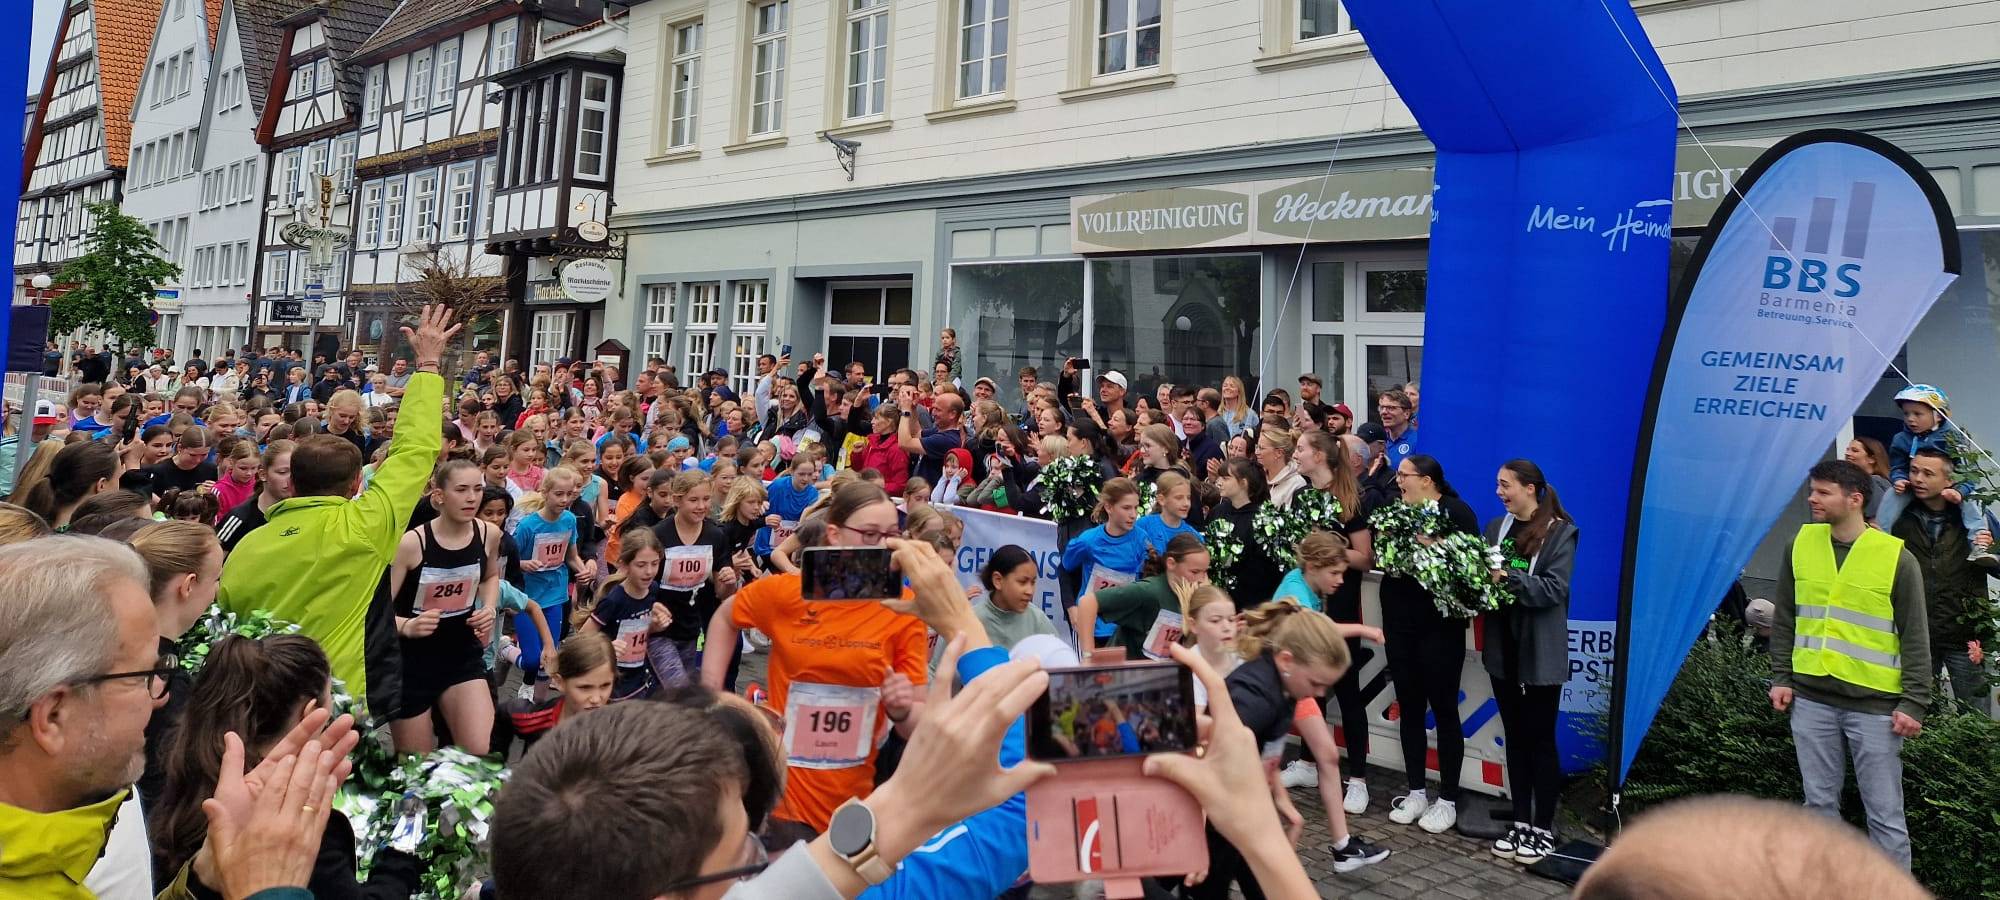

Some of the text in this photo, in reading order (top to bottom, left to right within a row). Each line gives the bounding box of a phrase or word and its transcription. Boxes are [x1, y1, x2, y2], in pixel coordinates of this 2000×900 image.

[1080, 202, 1244, 235] VOLLREINIGUNG
[1527, 204, 1595, 232] Mein
[1763, 256, 1861, 297] BBS
[1760, 292, 1857, 316] Barmenia
[1701, 351, 1844, 373] GEMEINSAM
[1733, 375, 1798, 394] ZIELE
[1694, 397, 1827, 420] ERREICHEN
[545, 543, 563, 555] 101
[678, 560, 701, 573] 100
[433, 582, 463, 598] 284
[810, 711, 852, 733] 196
